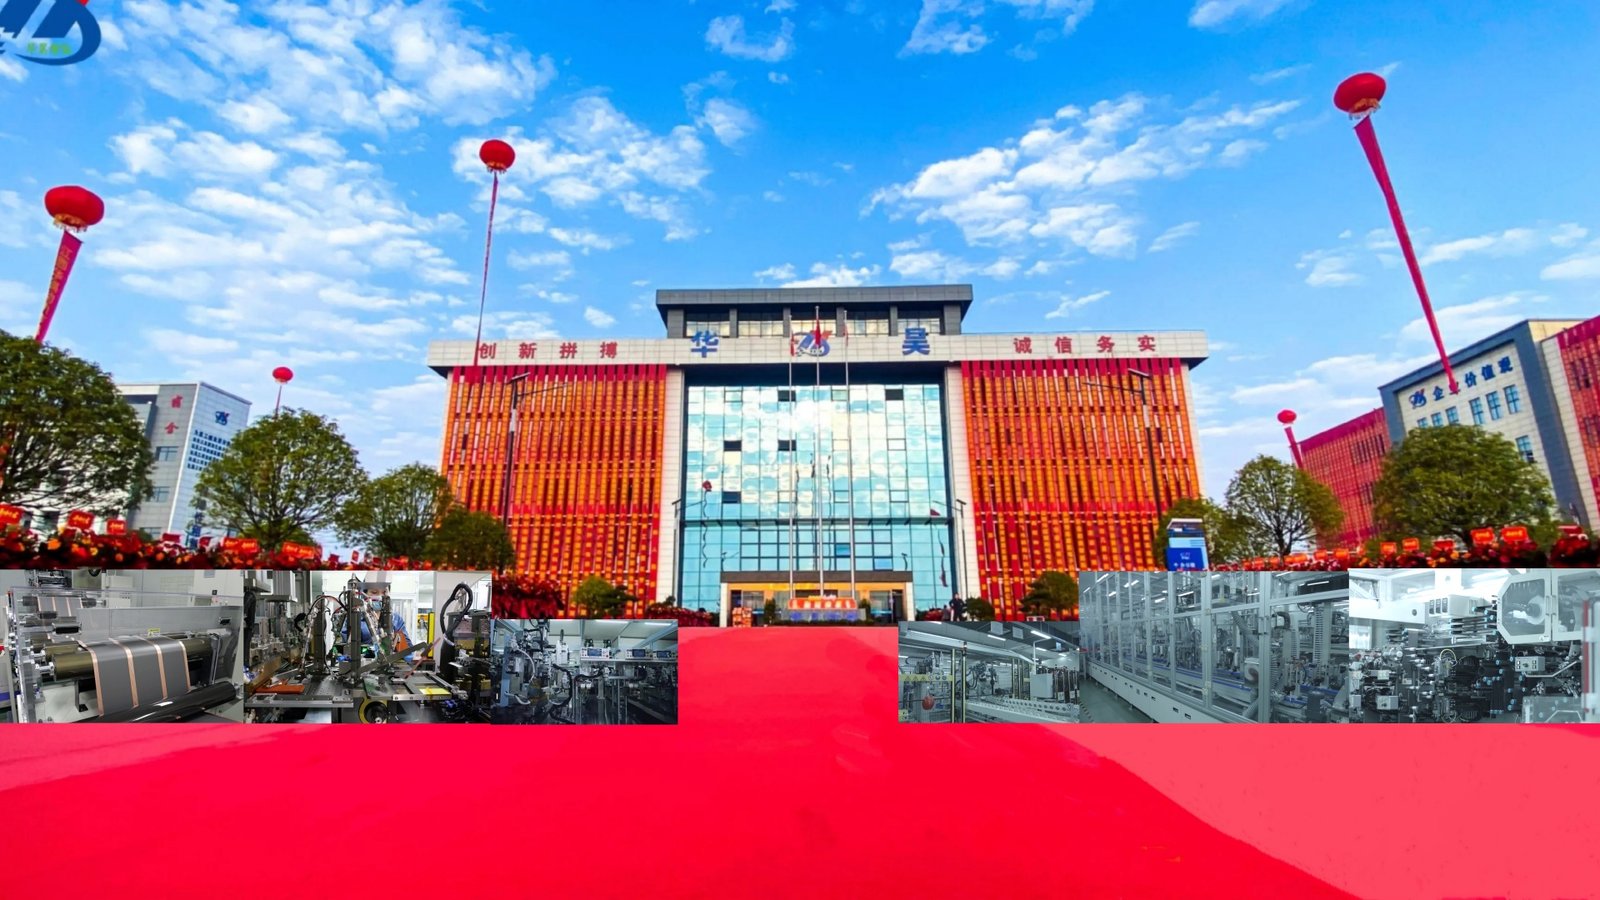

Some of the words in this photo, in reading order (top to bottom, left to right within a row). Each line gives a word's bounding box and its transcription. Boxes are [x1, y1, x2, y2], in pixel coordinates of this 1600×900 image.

[479, 341, 618, 360] 创新拼搏
[1013, 335, 1156, 354] 诚信务实
